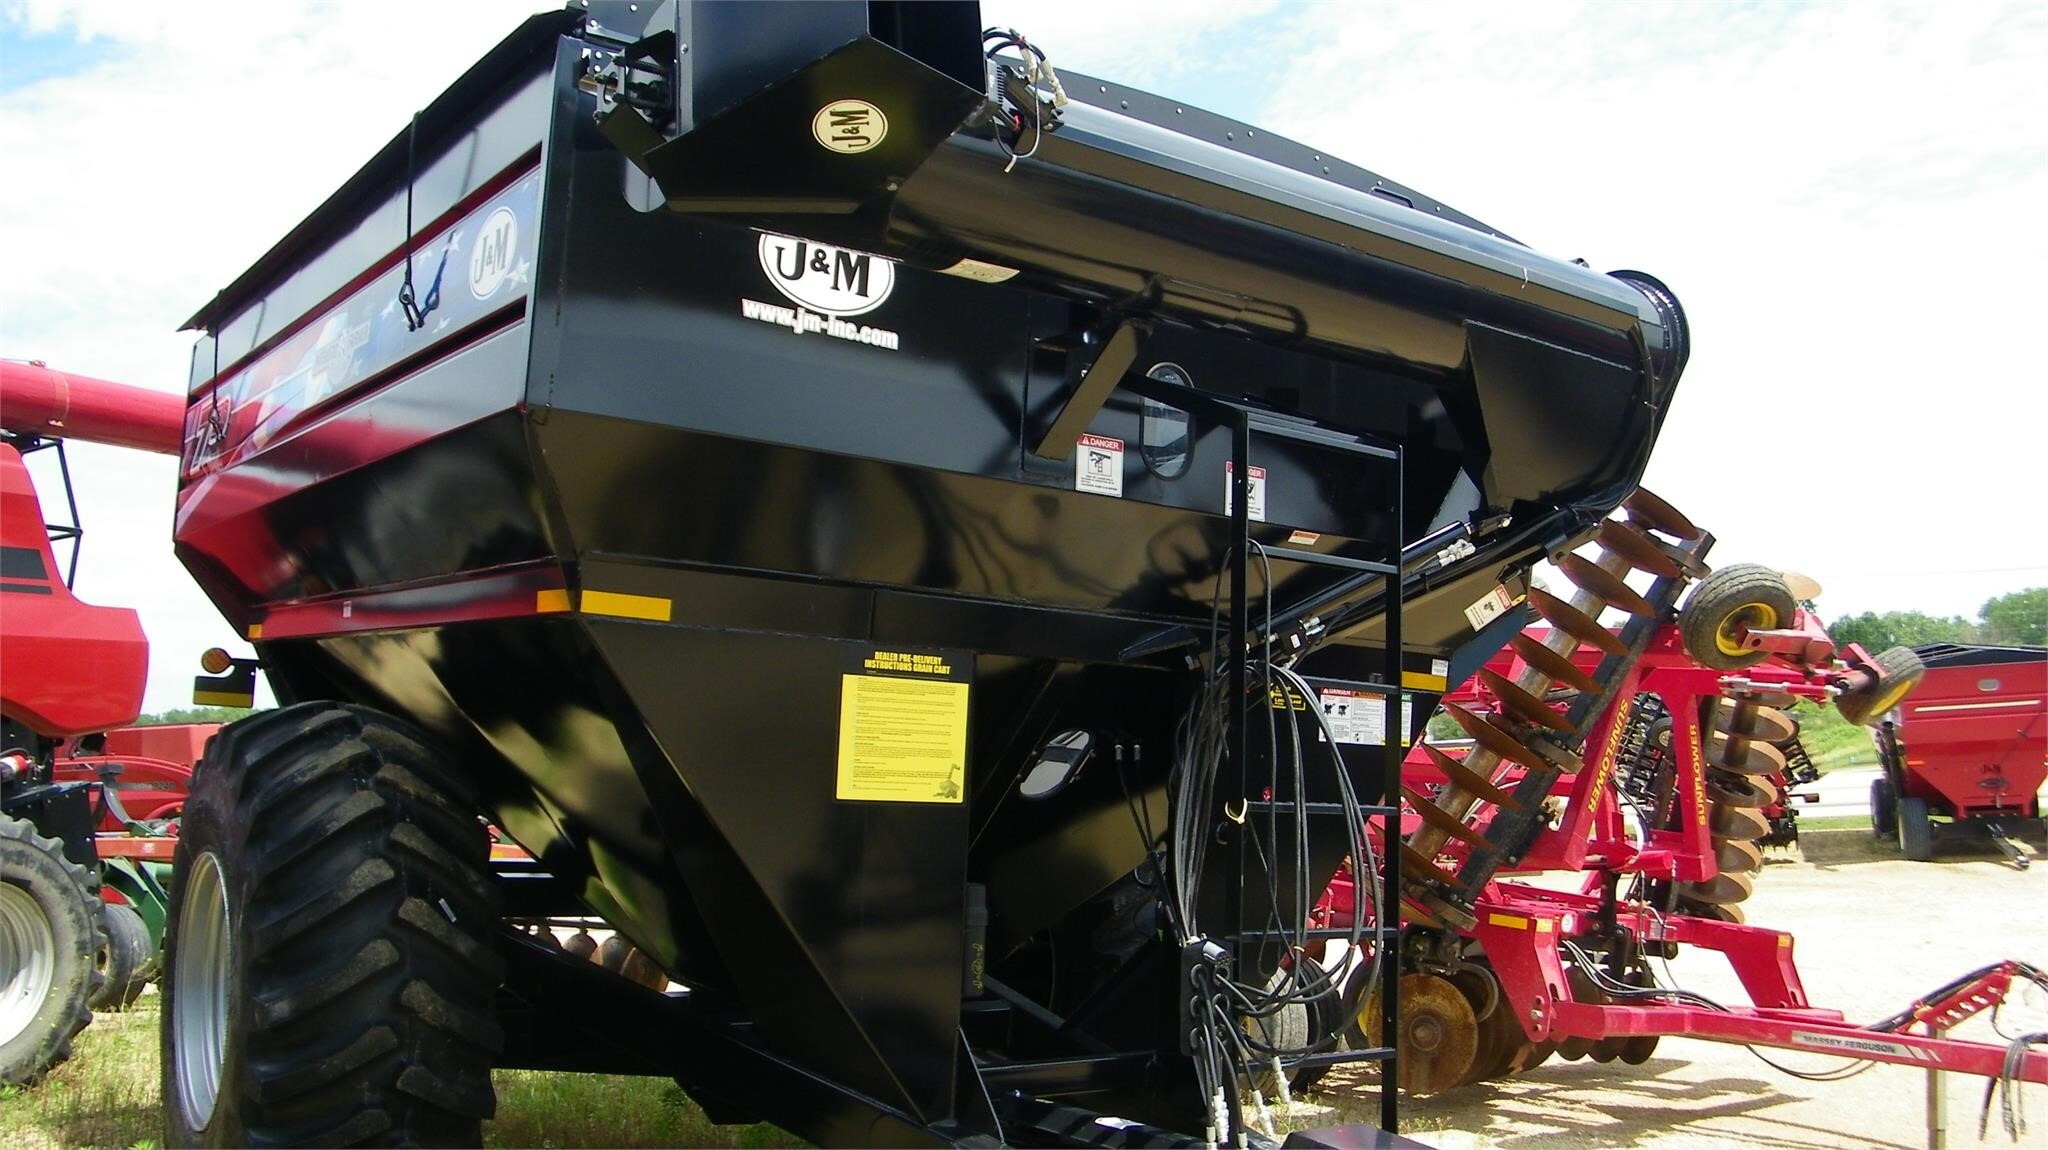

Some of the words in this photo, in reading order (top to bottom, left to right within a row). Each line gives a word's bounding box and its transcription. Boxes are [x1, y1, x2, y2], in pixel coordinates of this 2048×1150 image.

[829, 108, 871, 148] J&M
[474, 222, 511, 285] J&M
[774, 241, 871, 298] J&M
[741, 298, 899, 351] www.jm-inc.com
[1090, 437, 1120, 450] DANGER
[864, 659, 913, 671] INSTRUCTIONS
[913, 663, 933, 673] GRAIN
[933, 665, 951, 675] CART
[874, 651, 898, 661] DEALER
[899, 653, 943, 665] PRE-DELIVERY
[1587, 698, 1629, 814] SUNFLOWER
[1689, 723, 1706, 827] SUNFLOWER
[1803, 1034, 1842, 1046] MASSEY
[1844, 1040, 1897, 1054] FERGUSON
